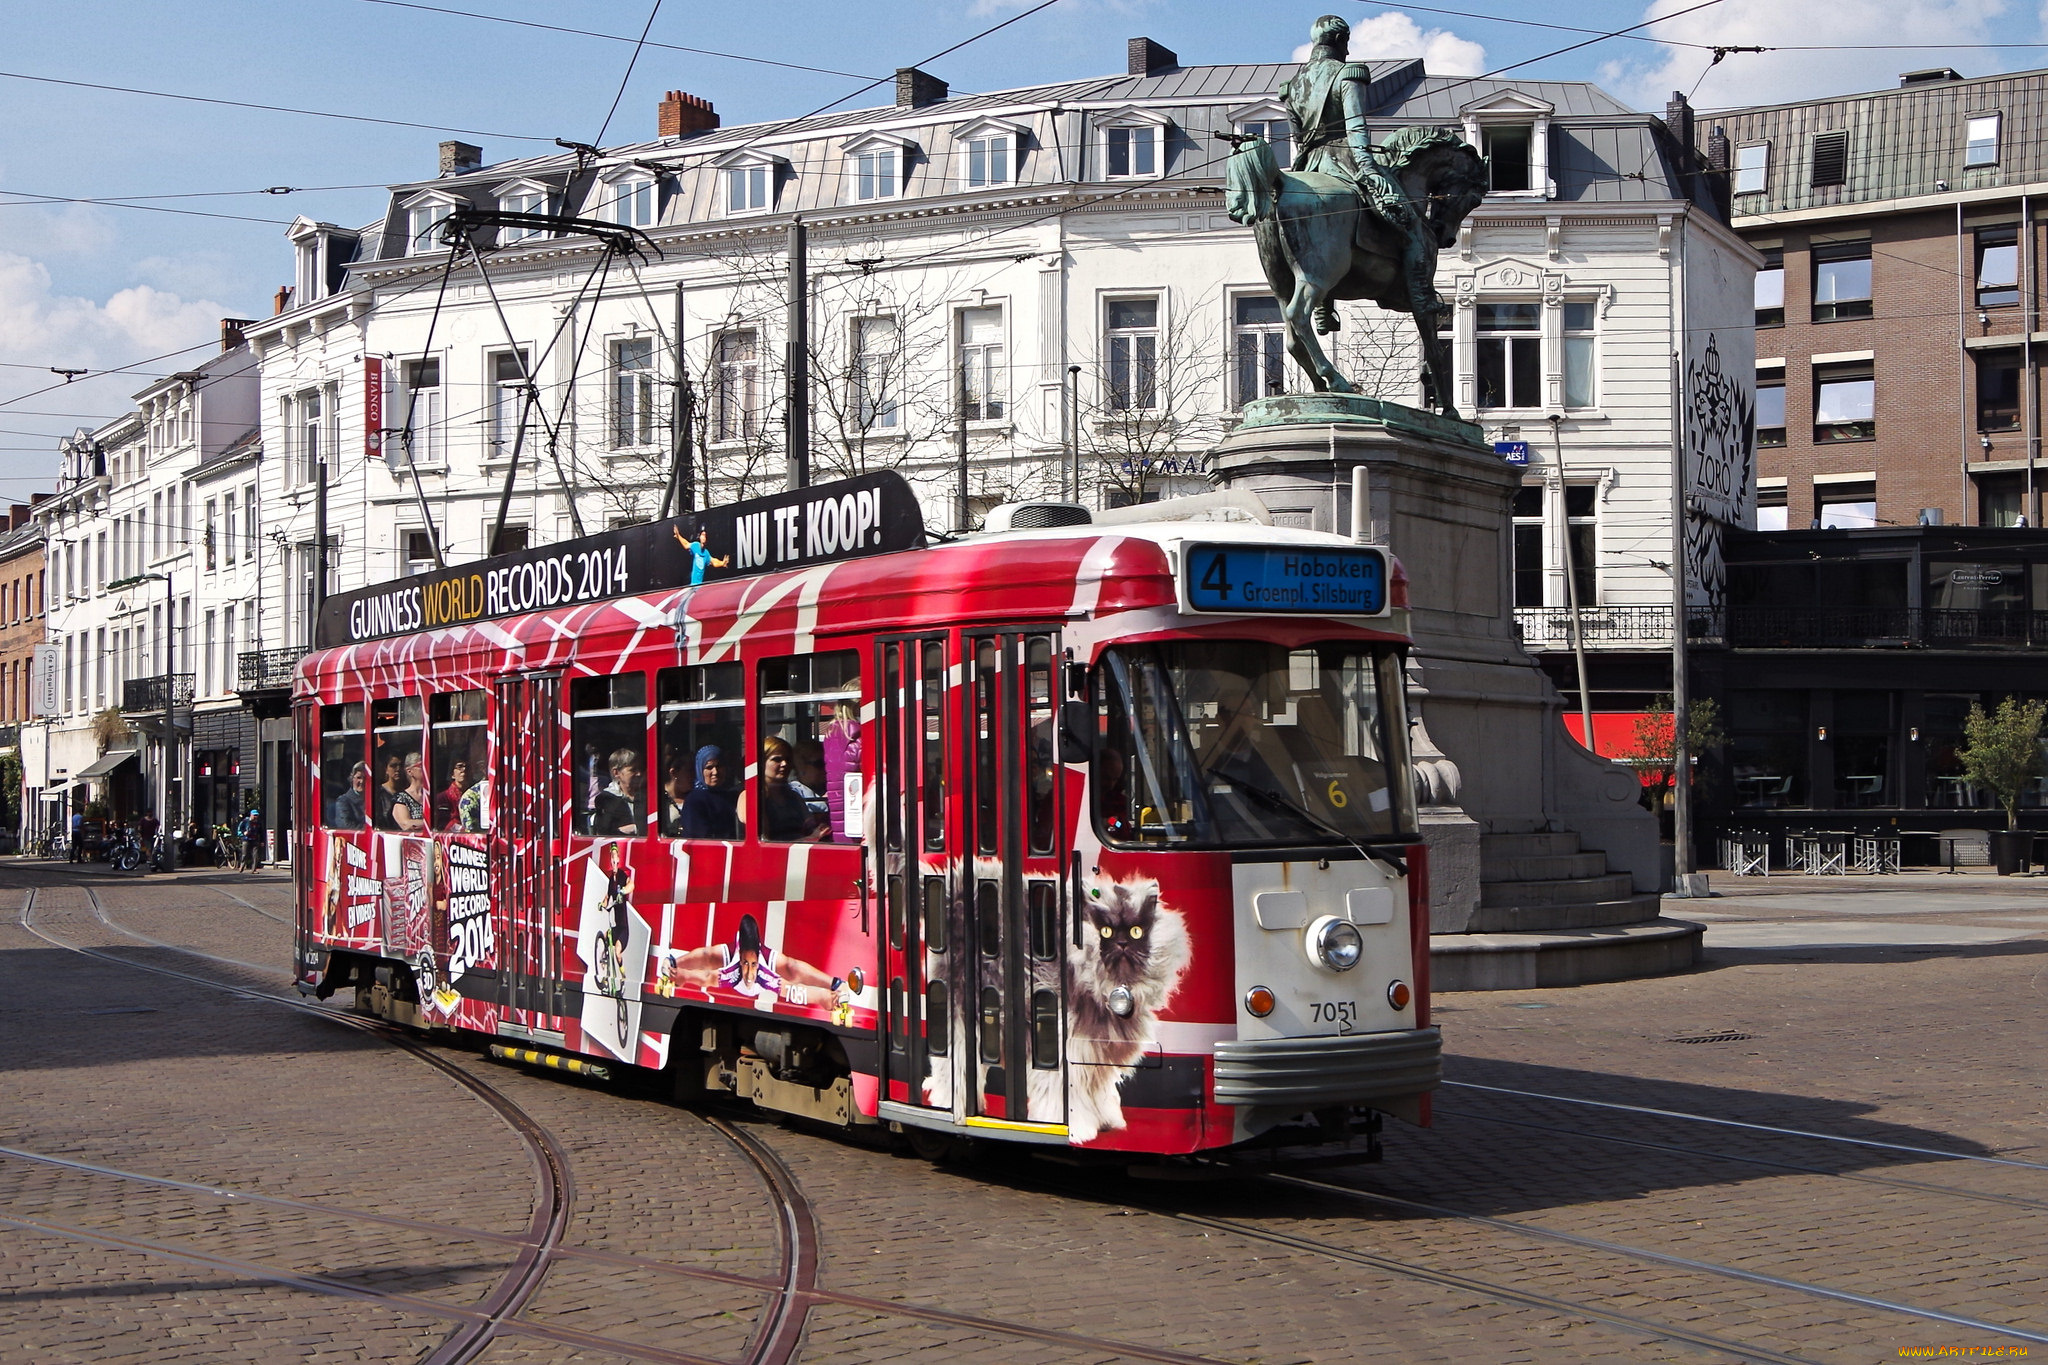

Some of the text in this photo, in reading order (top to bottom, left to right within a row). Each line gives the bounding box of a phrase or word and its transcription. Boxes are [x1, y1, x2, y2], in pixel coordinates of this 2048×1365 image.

[370, 372, 379, 421] BIANCO
[1696, 450, 1731, 496] ZORO
[736, 487, 882, 569] NU TE KOOP!
[1200, 553, 1233, 601] 4
[1284, 556, 1374, 578] Hoboken
[350, 545, 629, 639] GUINNESS WORLD RECORDS 2014
[1242, 581, 1373, 608] Groenpl. Silsburg
[1328, 780, 1348, 808] 6
[449, 844, 488, 868] GUINNESS
[450, 866, 488, 893] WORLD
[450, 894, 491, 921] RECORDS
[449, 912, 495, 974] 2014
[422, 971, 434, 990] 3D
[785, 985, 808, 1005] 7051
[1310, 1001, 1358, 1023] 7051
